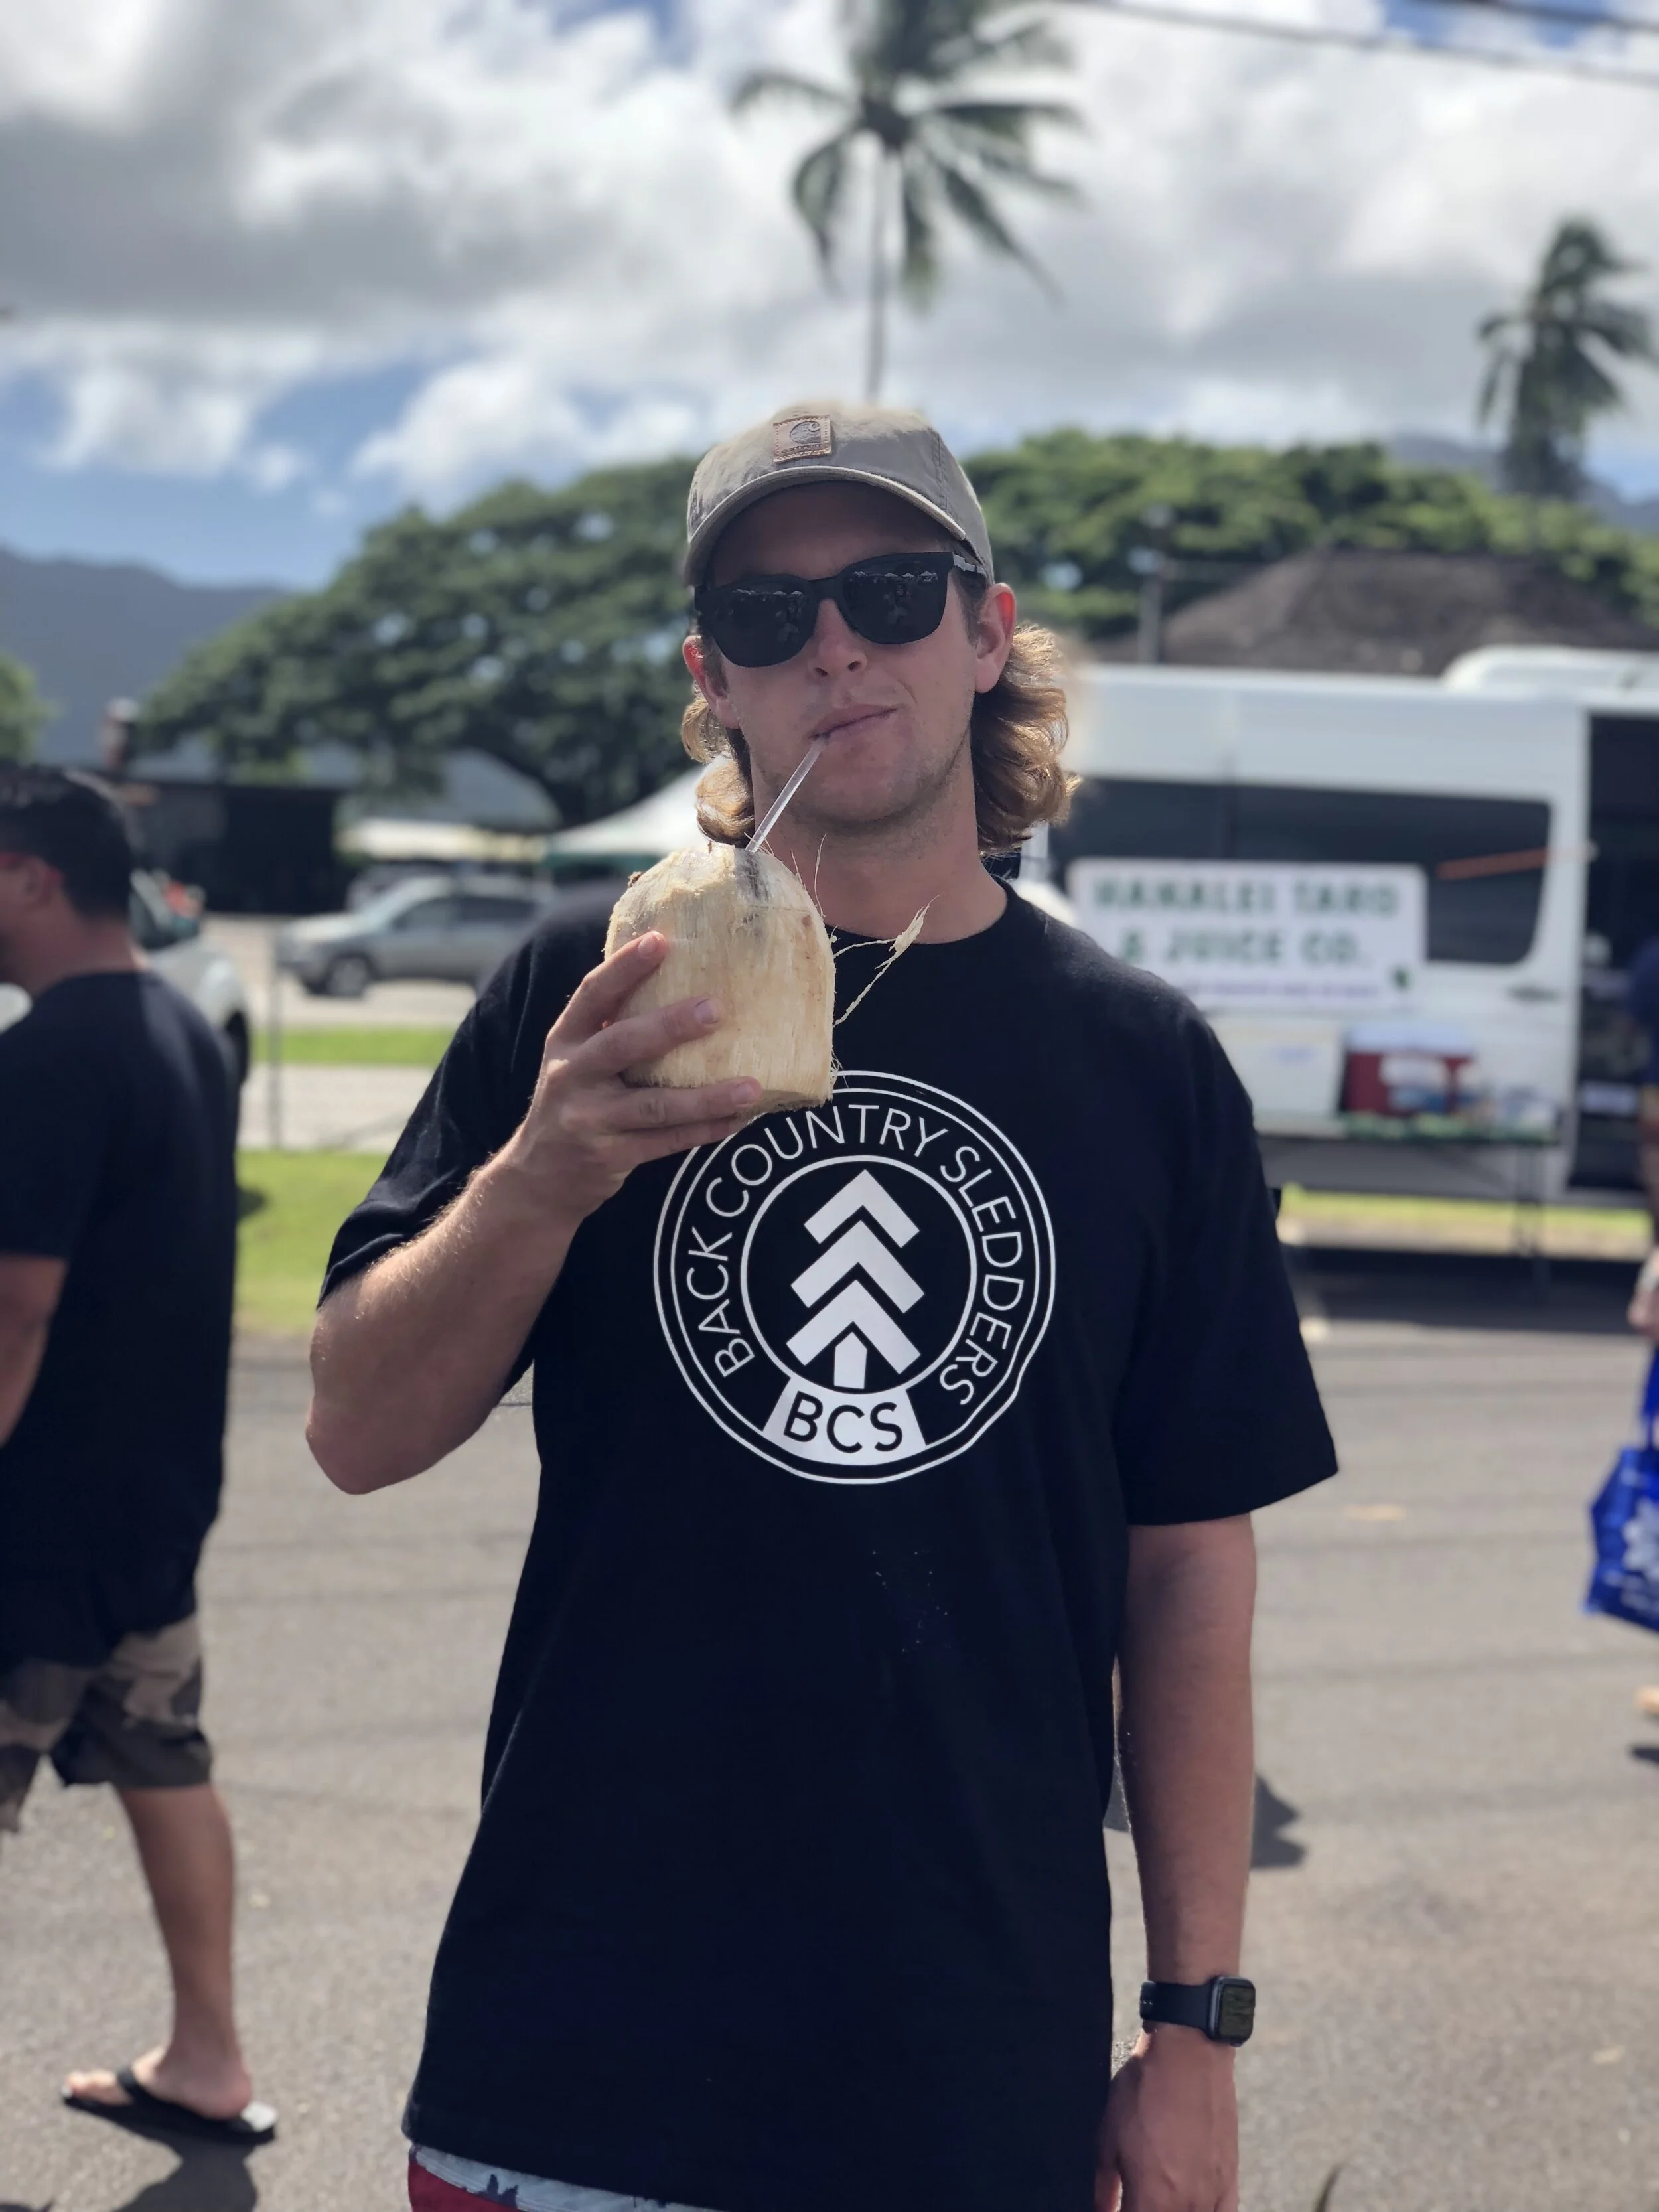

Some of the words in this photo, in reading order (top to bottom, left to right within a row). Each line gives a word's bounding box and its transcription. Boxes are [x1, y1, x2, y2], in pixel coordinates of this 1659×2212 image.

[707, 1104, 948, 1217] COUNTRY
[687, 1227, 755, 1377] BACK
[940, 1147, 1025, 1405] SLEDDERS
[784, 1391, 903, 1453] BCS
